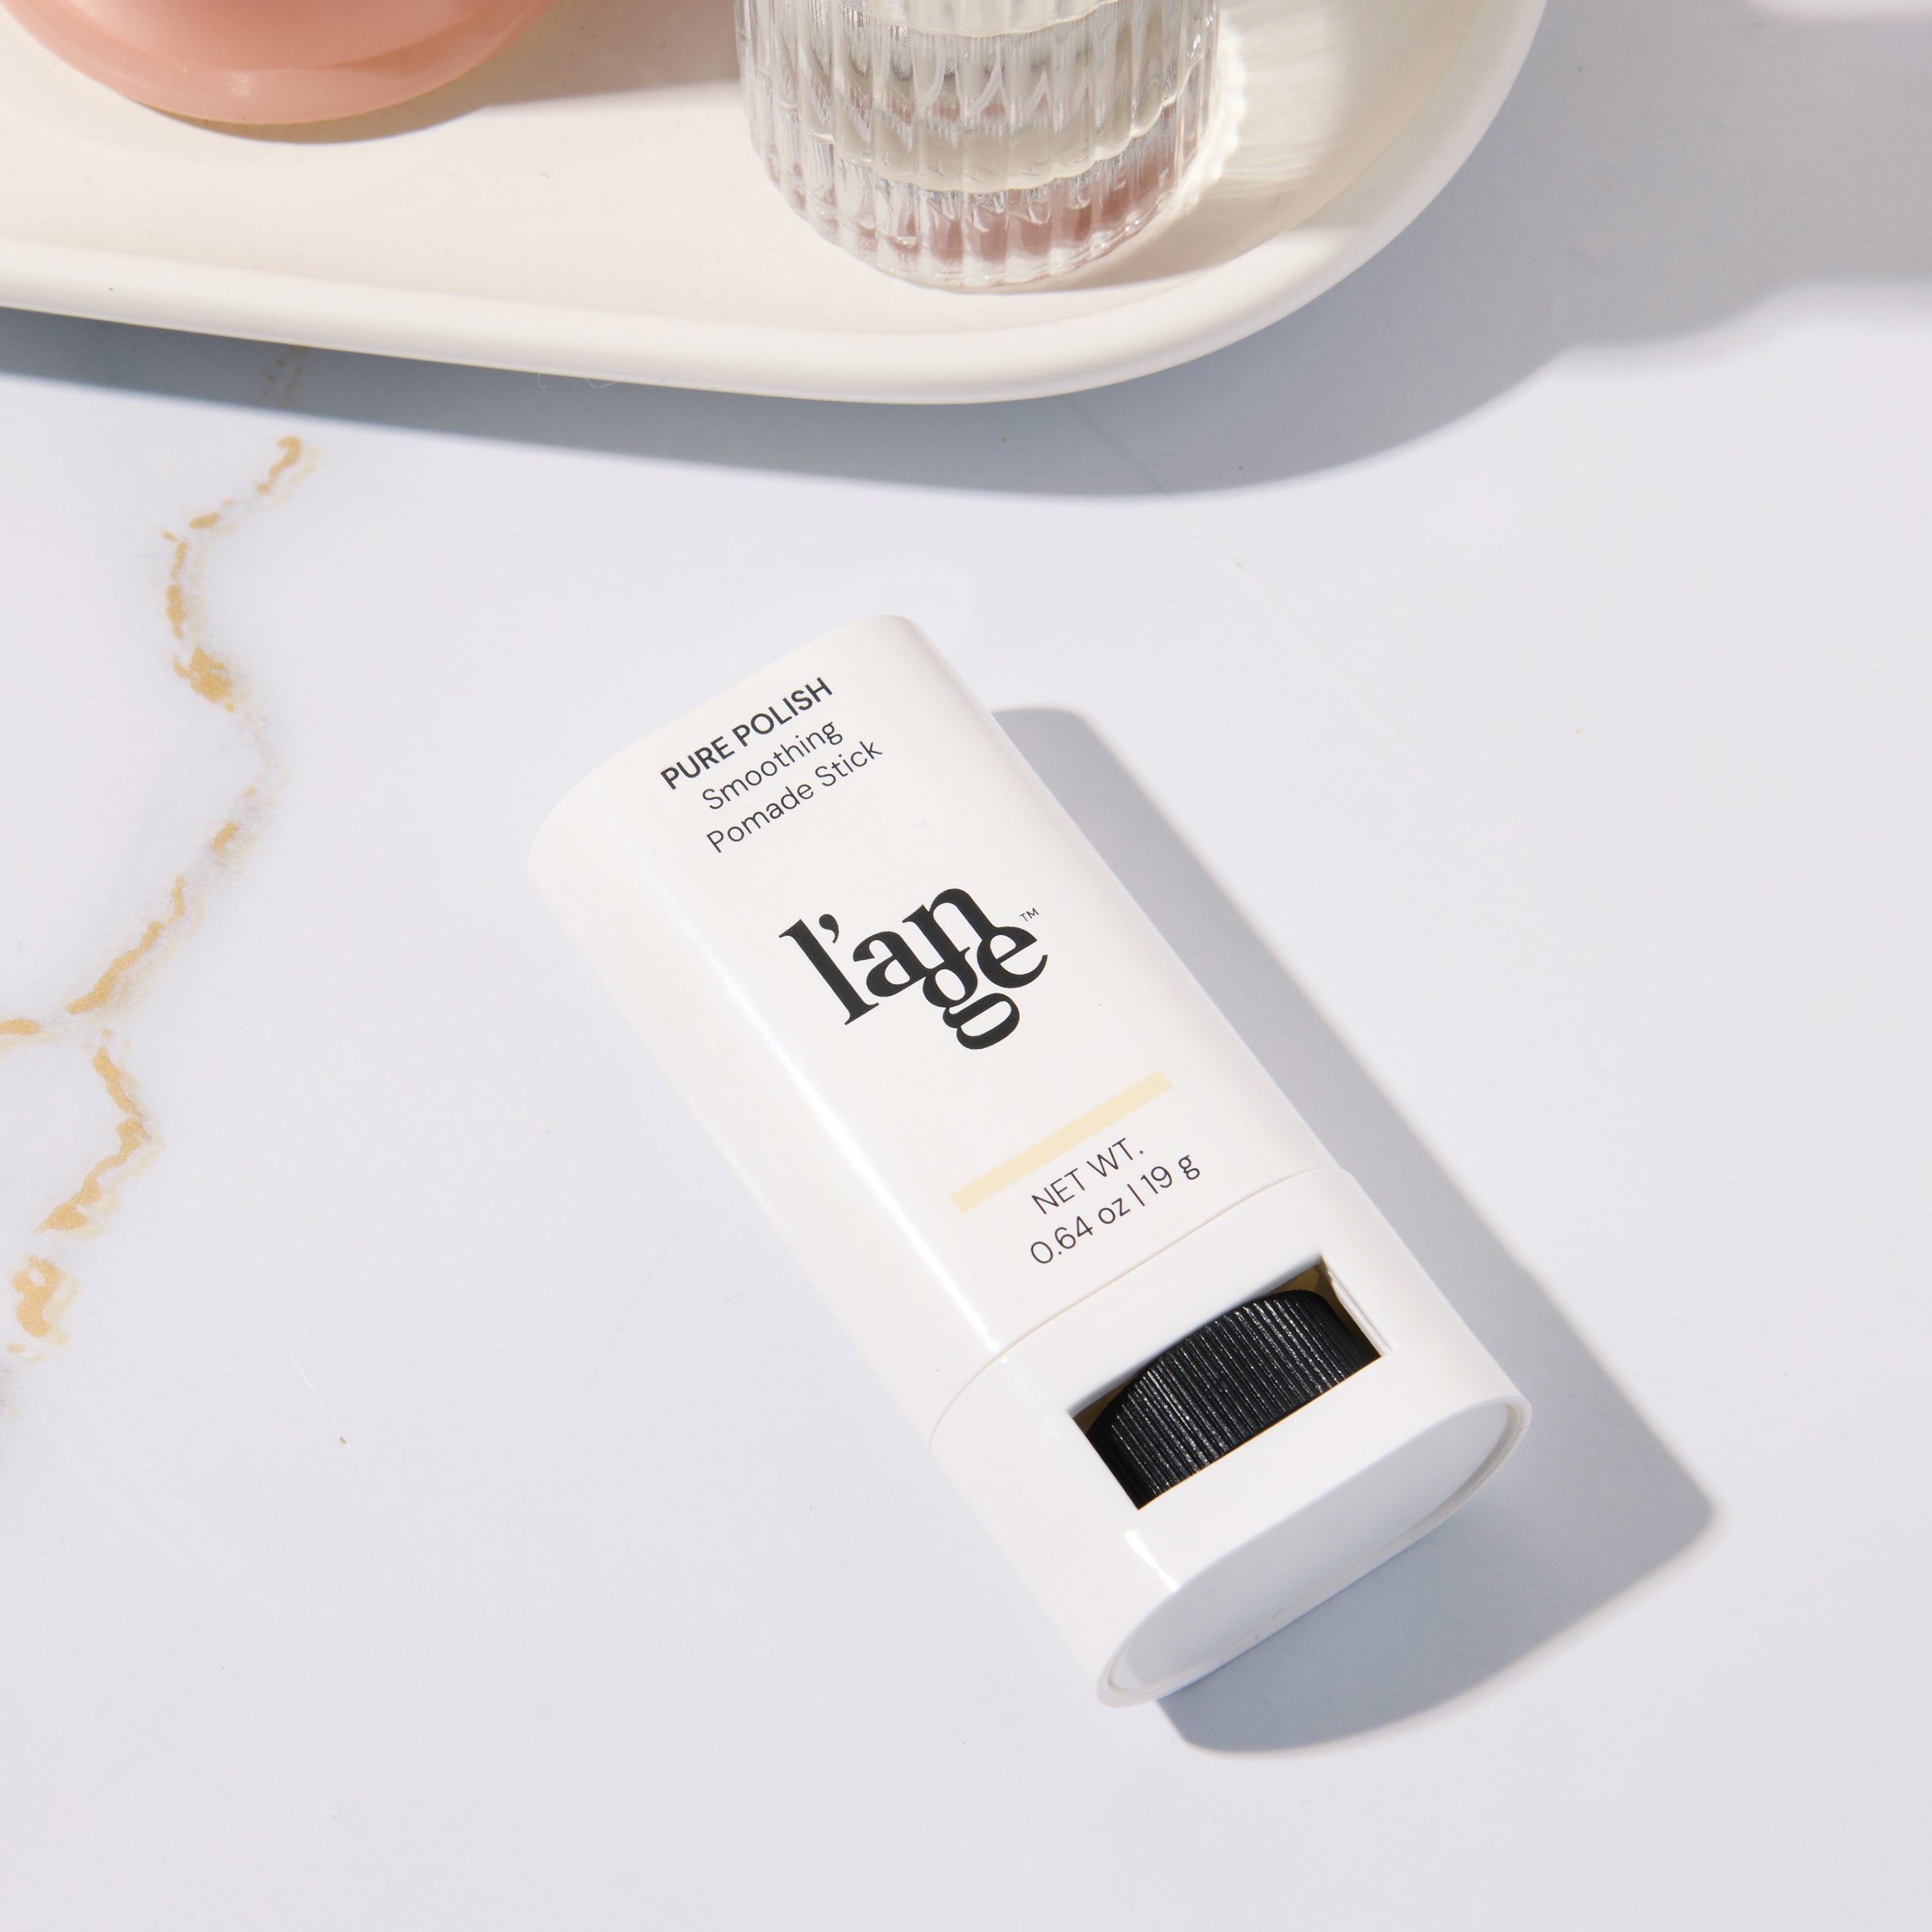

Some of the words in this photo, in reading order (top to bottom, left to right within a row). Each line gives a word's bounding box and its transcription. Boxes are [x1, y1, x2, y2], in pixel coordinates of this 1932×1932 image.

[659, 735, 736, 791] PURE
[731, 676, 833, 748] POLISH
[701, 721, 844, 811] Smoothing
[705, 783, 815, 853] Pomade
[815, 740, 883, 787] Stick
[1030, 1167, 1086, 1216] NET
[1085, 1137, 1145, 1178] WT.
[1030, 1215, 1094, 1265] 0.64
[1097, 1197, 1131, 1225] oz
[1140, 1166, 1173, 1195] 19
[1178, 1154, 1201, 1181] g
